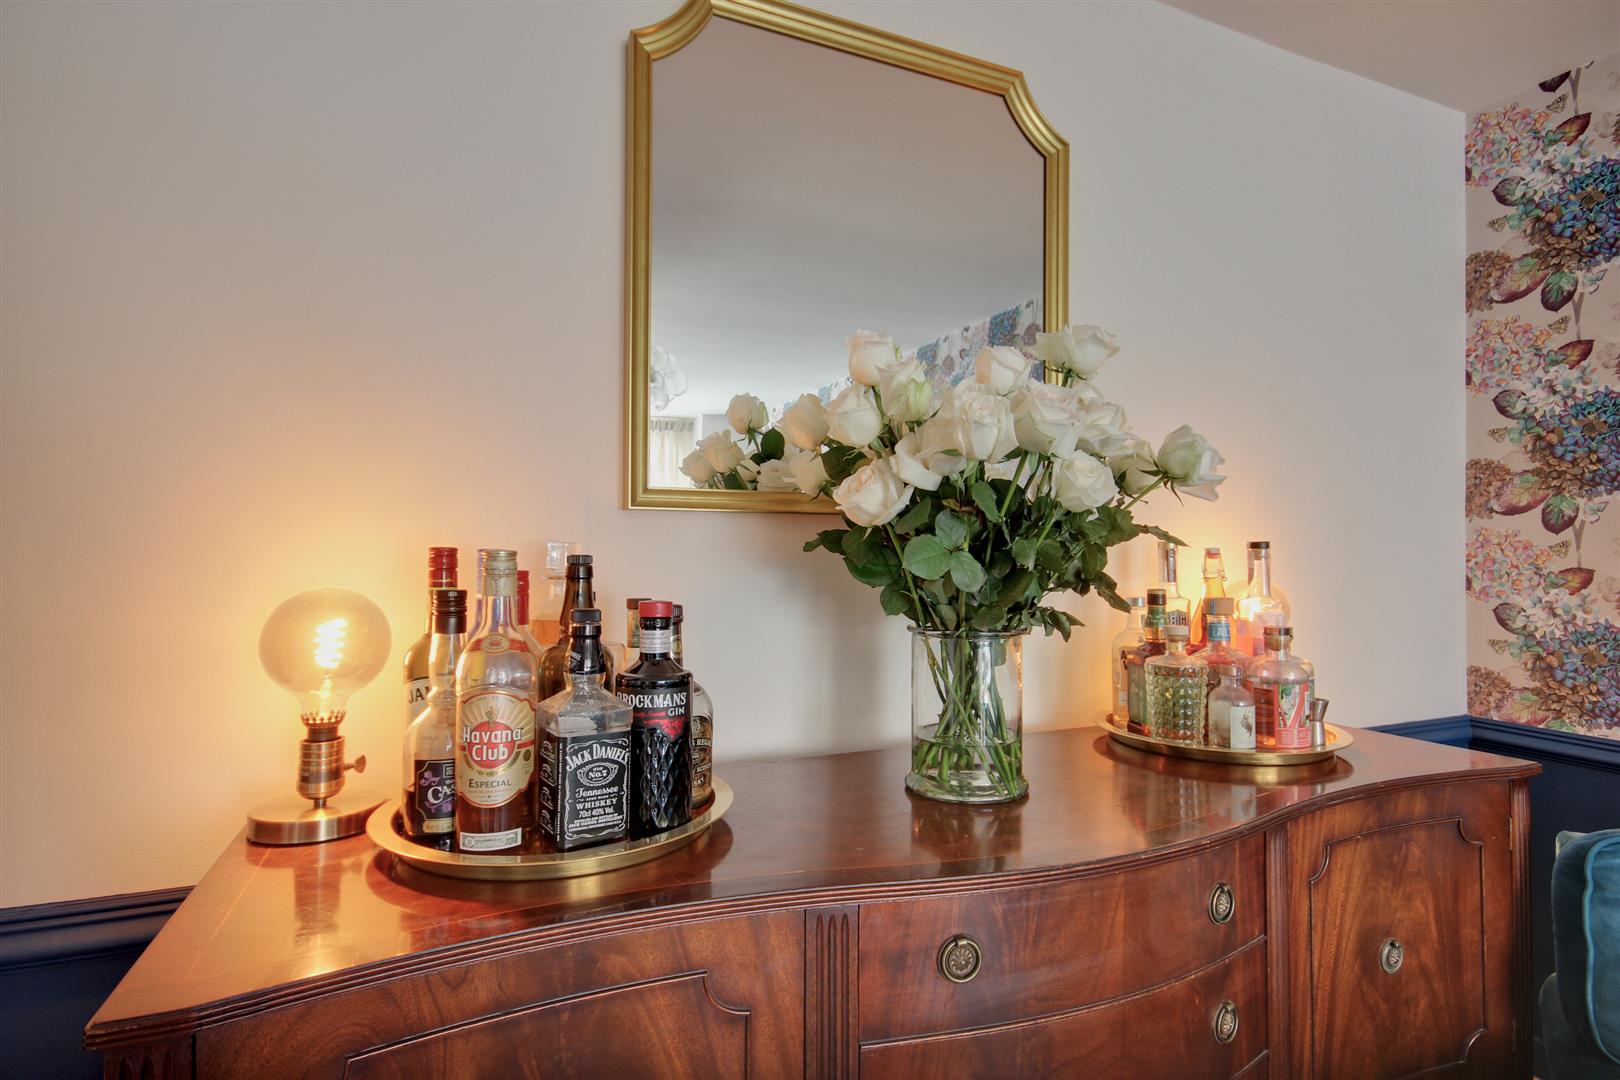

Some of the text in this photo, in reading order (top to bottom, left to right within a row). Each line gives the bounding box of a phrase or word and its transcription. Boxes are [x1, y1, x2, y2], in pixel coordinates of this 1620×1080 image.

[668, 707, 685, 716] GIN
[463, 725, 522, 744] Havana
[472, 743, 510, 761] Club
[565, 748, 591, 772] JACK
[468, 778, 512, 788] ESPECIAL
[575, 786, 619, 799] Tennessee
[576, 798, 618, 810] WHISKEY
[578, 809, 591, 818] 70cl
[591, 807, 605, 816] 40%
